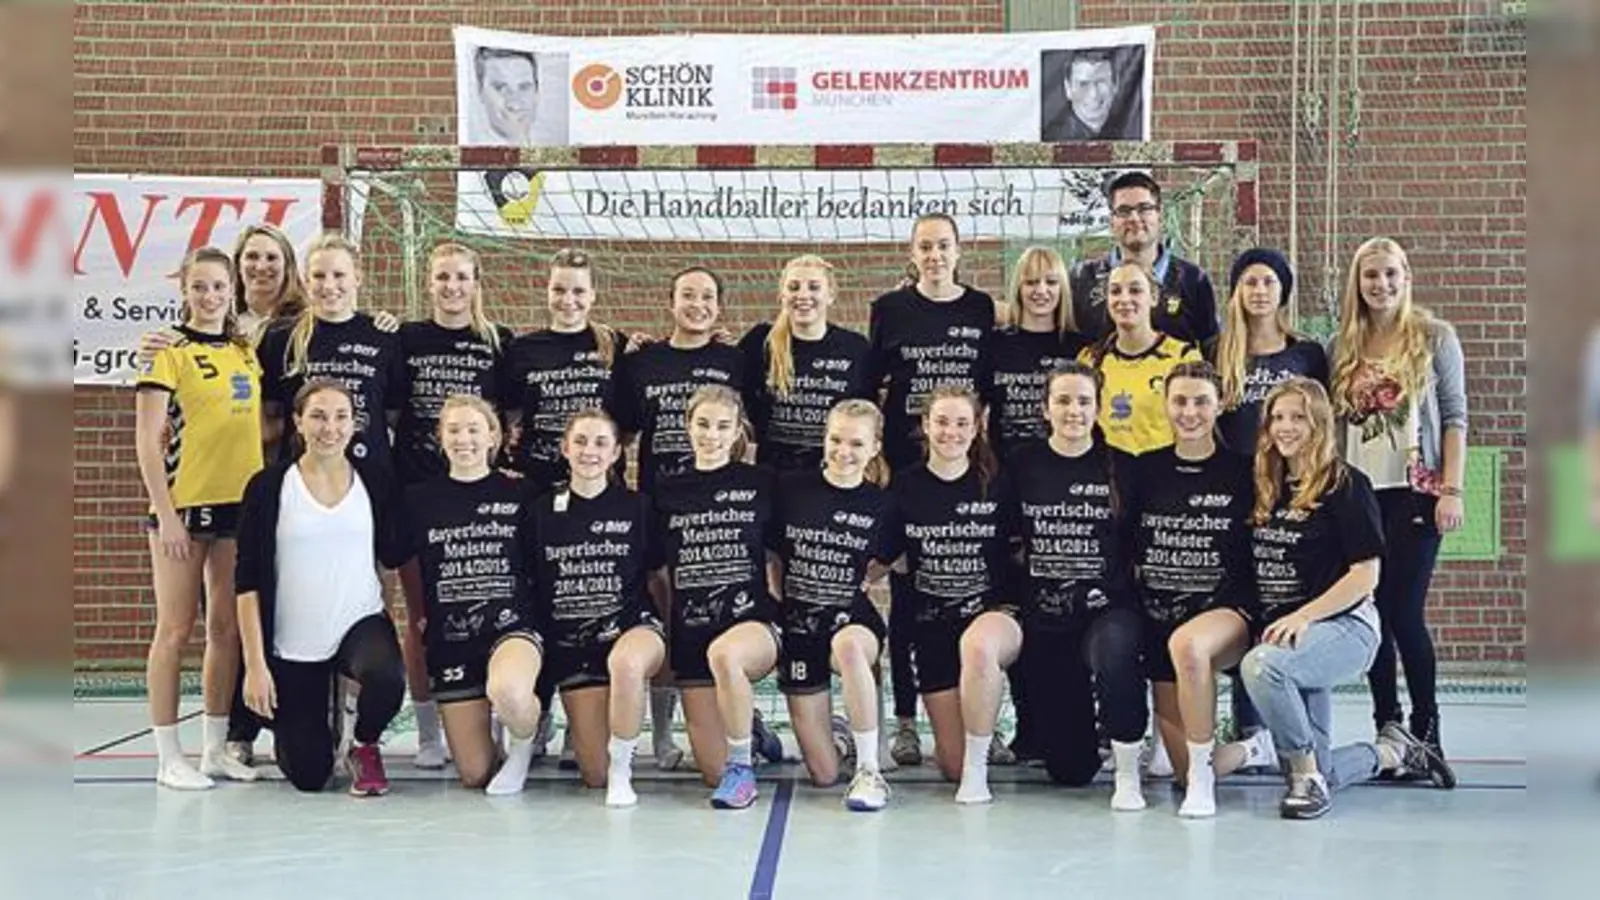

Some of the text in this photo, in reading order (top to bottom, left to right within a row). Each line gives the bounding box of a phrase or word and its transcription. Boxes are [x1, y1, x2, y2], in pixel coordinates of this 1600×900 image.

[625, 62, 714, 84] SCHÖN
[812, 69, 1029, 91] GELENKZENTRUM
[625, 87, 714, 107] KLINIK
[586, 182, 1025, 220] Die Handballer bedanken sich
[84, 296, 103, 320] &
[193, 355, 219, 379] 5
[669, 508, 756, 529] Bayerischer
[1033, 519, 1094, 537] Meister
[428, 520, 517, 544] Bayerischer
[682, 526, 742, 546] Meister
[905, 521, 997, 540] Bayerischer
[1152, 530, 1214, 549] Meister
[444, 541, 503, 560] Meister
[545, 540, 631, 561] Bayerischer
[678, 543, 748, 564] 2014/2015
[793, 542, 852, 565] Meister
[921, 541, 983, 556] Meister
[1146, 549, 1221, 567] 2014/2015
[439, 558, 511, 578] 2014/2015
[557, 560, 617, 577] Meister
[790, 661, 808, 681] 18
